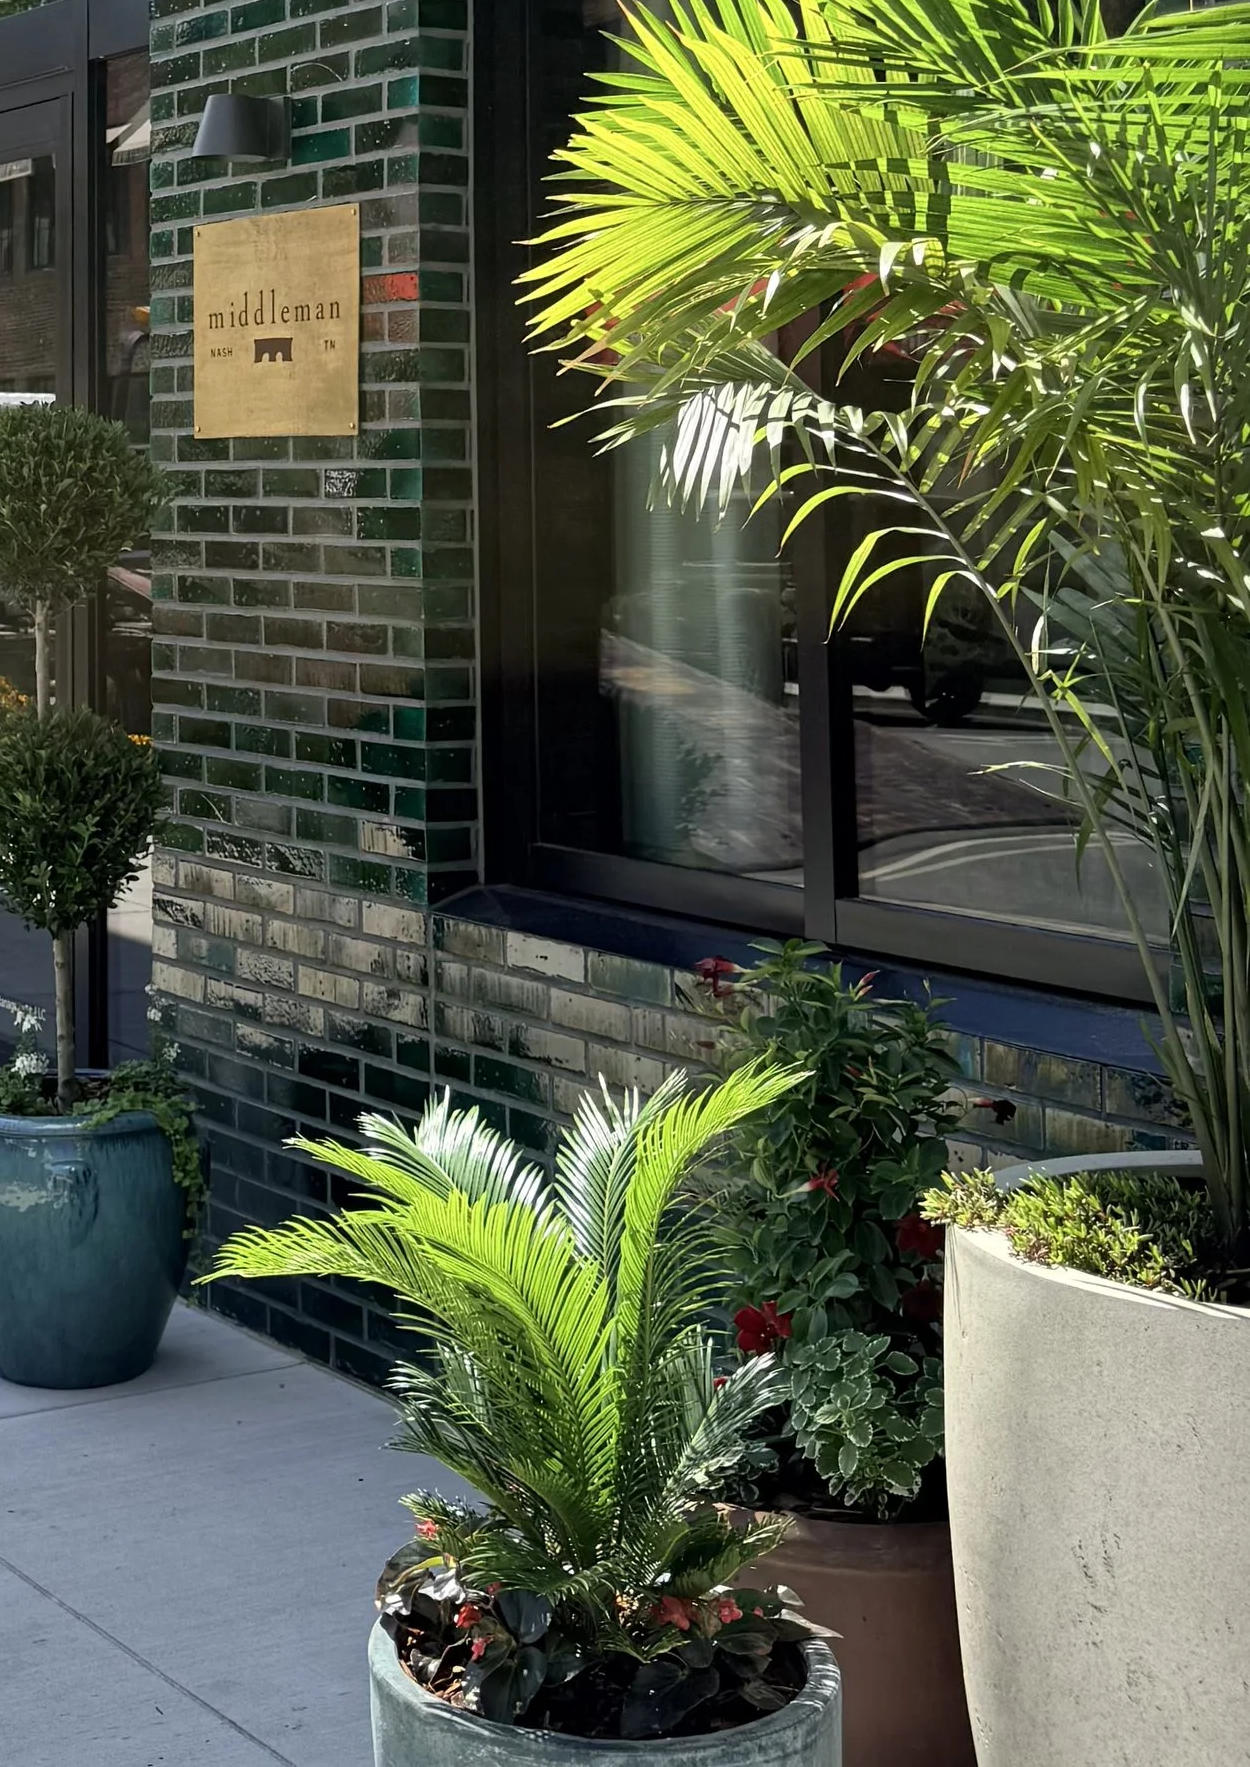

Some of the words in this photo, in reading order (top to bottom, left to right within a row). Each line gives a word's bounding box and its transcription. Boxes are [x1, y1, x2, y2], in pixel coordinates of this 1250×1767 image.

[208, 288, 341, 330] middleman
[210, 347, 233, 358] NASH
[323, 339, 336, 351] TN
